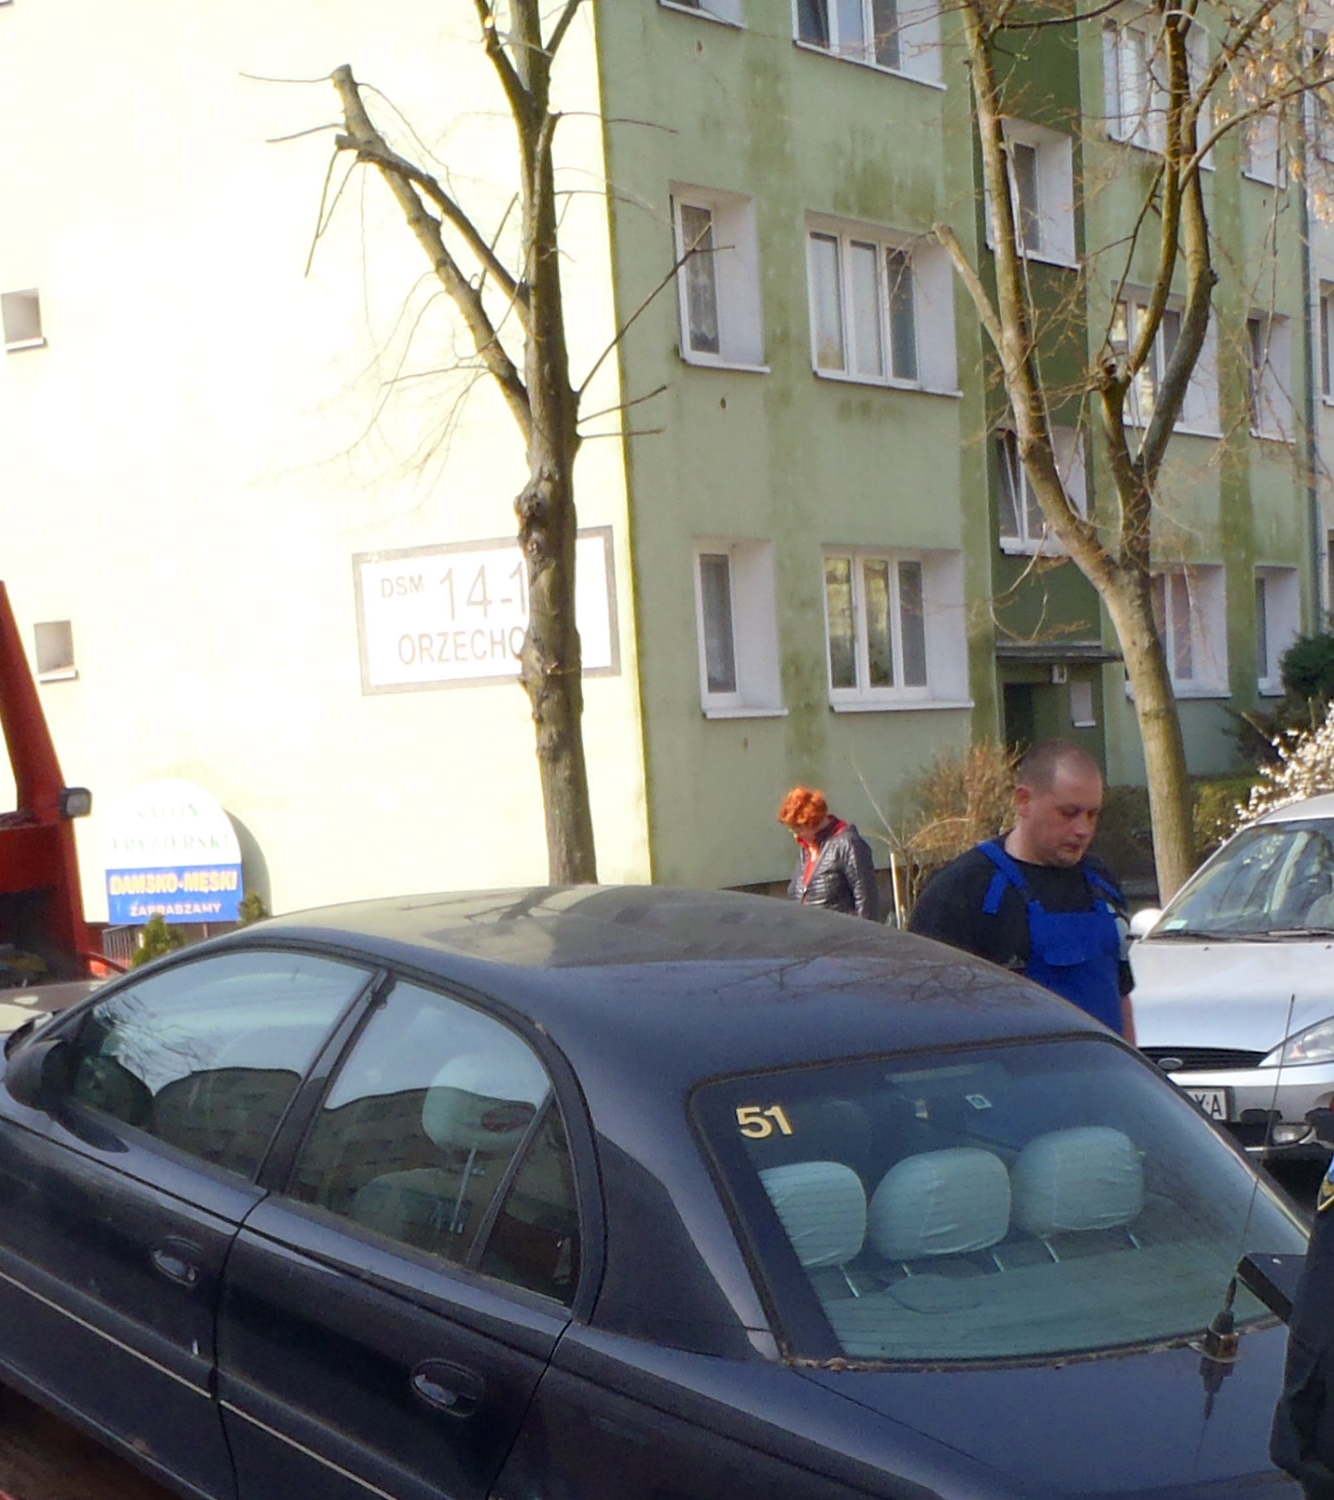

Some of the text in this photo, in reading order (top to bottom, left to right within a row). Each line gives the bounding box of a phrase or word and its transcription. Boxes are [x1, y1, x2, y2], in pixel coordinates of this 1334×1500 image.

[380, 561, 527, 621] DSM 14-1
[398, 626, 527, 666] ORZECHO
[736, 1105, 793, 1138] 51
